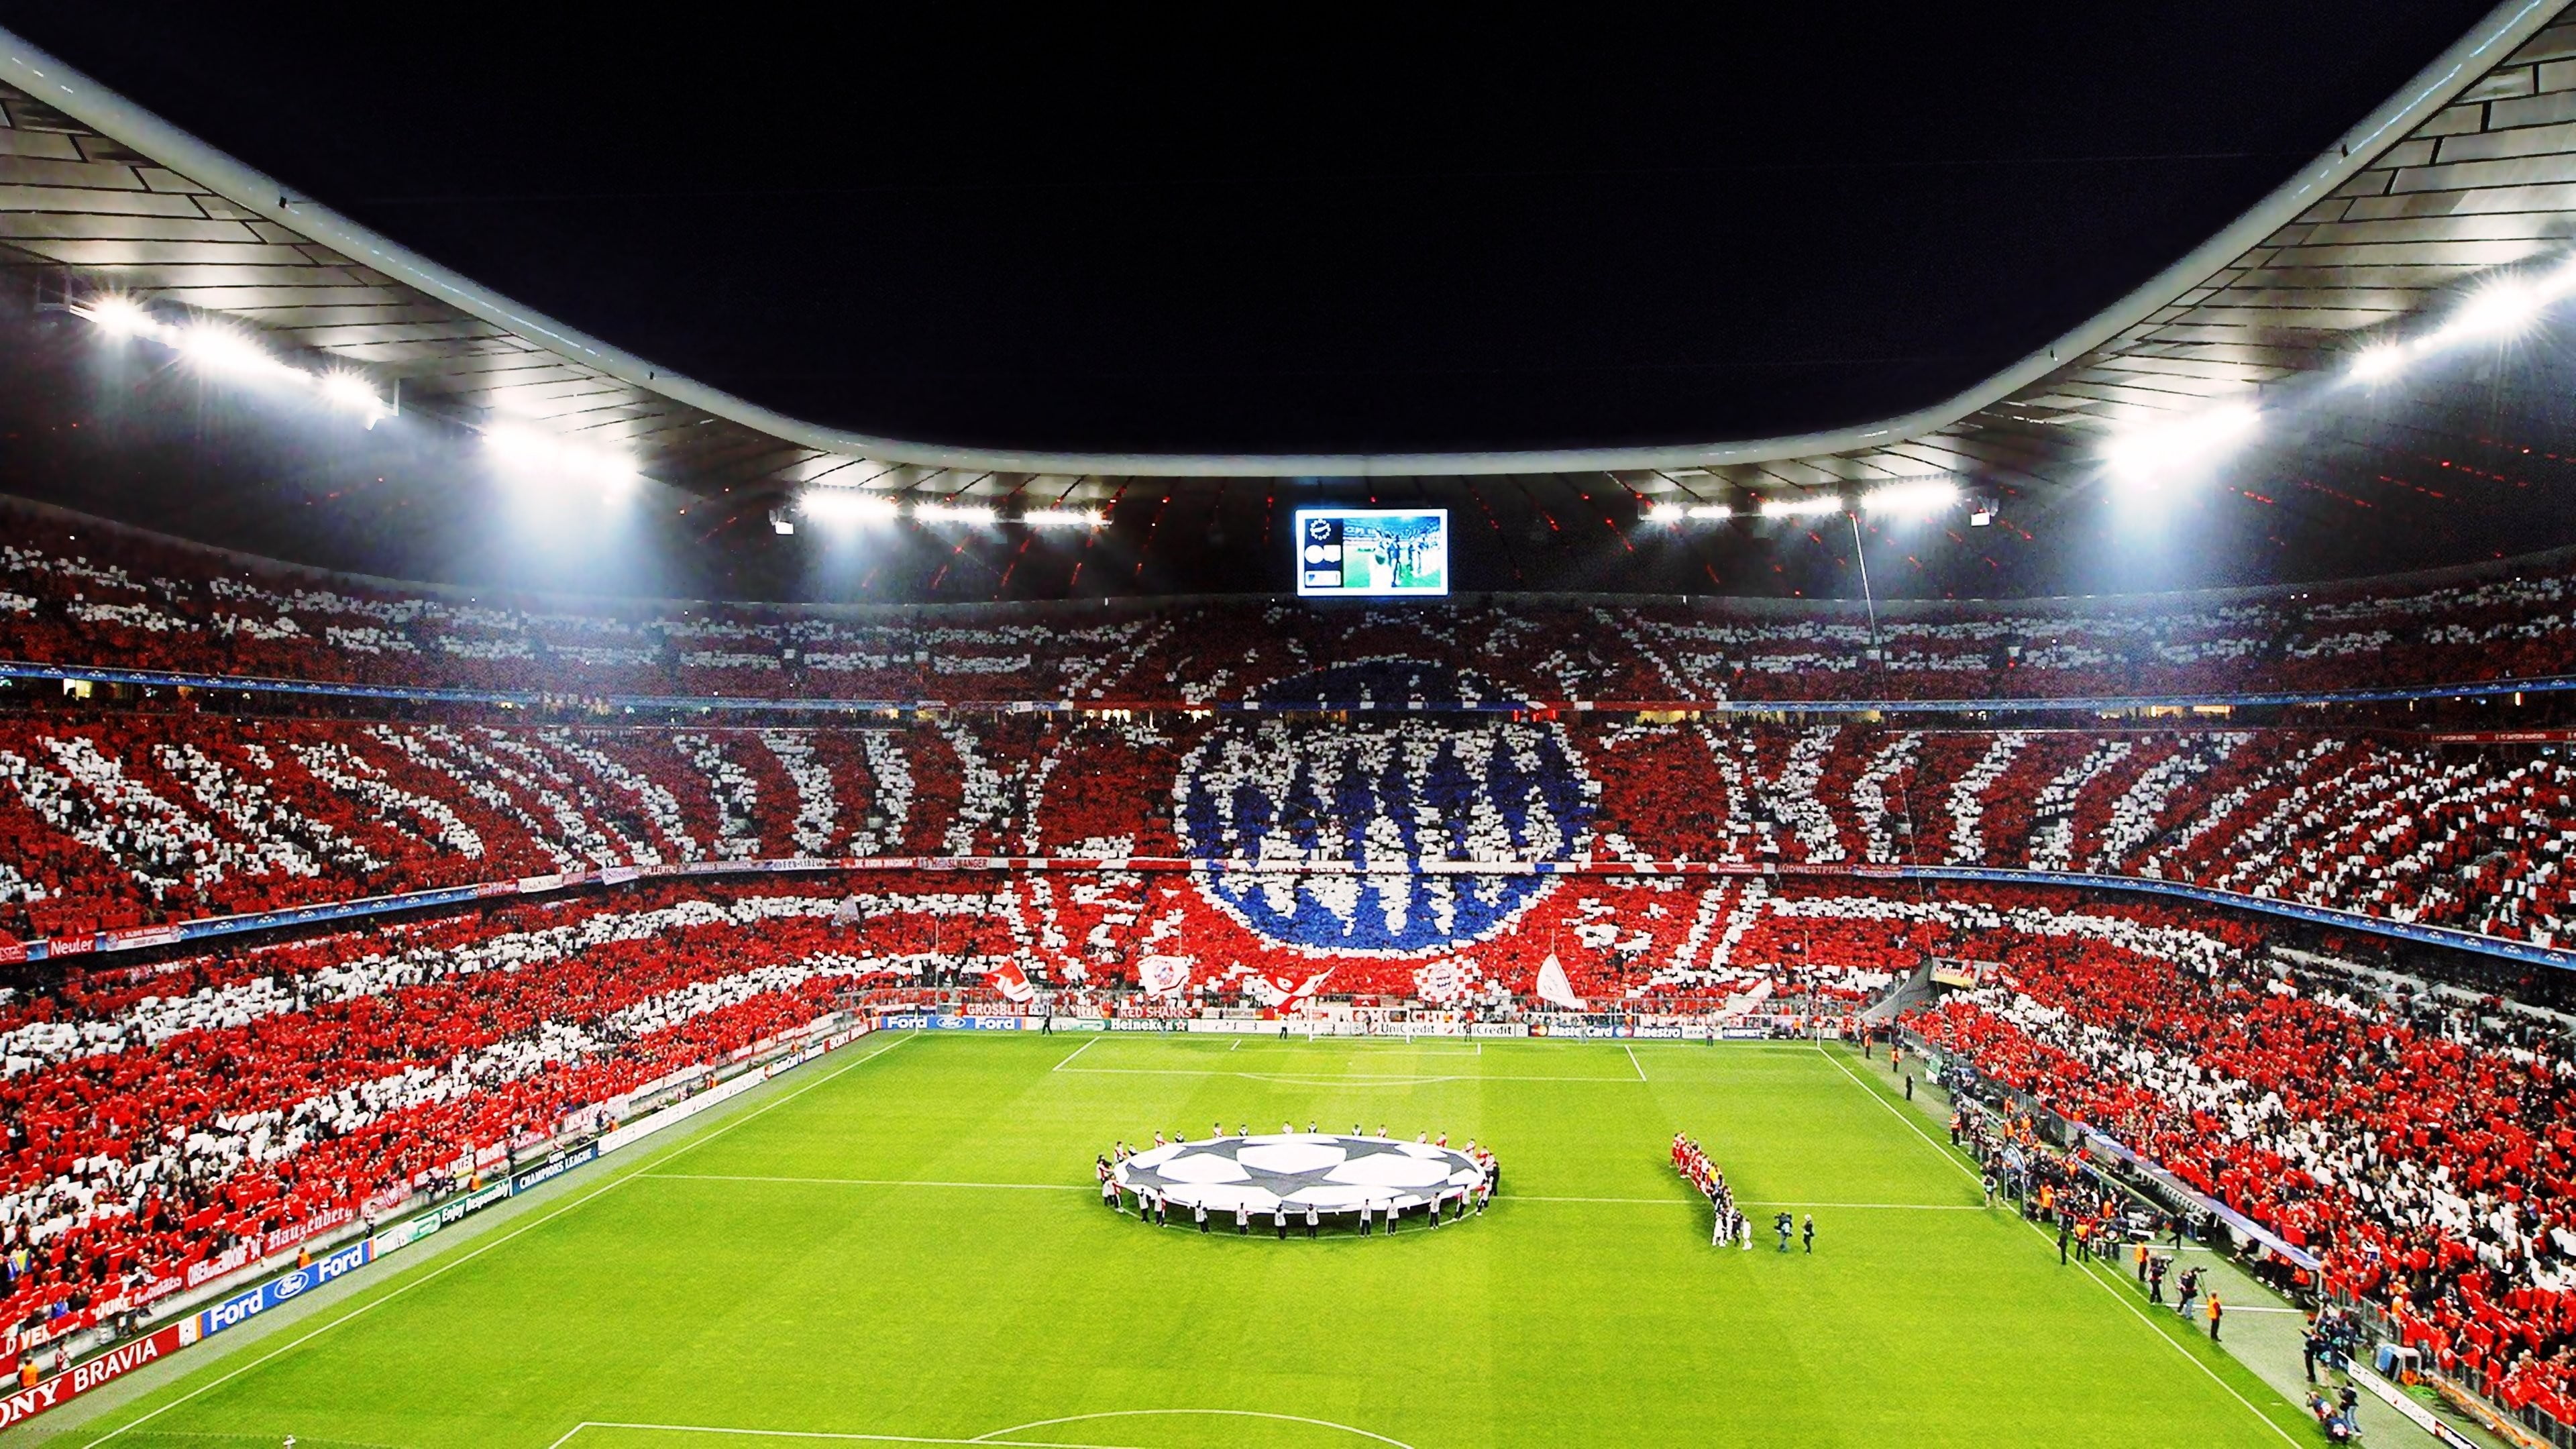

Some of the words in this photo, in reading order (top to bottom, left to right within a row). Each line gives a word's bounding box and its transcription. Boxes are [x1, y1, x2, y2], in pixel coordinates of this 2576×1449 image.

[50, 939, 94, 956] Neuler
[1120, 1006, 1143, 1018] RED
[1146, 1006, 1193, 1018] SHARKS
[887, 1016, 928, 1029] Ford
[975, 1017, 1015, 1030] Ford
[1381, 1021, 1434, 1034] UniCredit
[1457, 1022, 1512, 1035] UiCredit
[1633, 1026, 1681, 1038] Maestro
[519, 1161, 565, 1189] CHAMPIONS
[565, 1148, 592, 1171] LEAGUE
[441, 1203, 465, 1224] Enjoy
[466, 1181, 510, 1214] Responsibly
[268, 1207, 353, 1251] Hauzenberg
[319, 1242, 363, 1283] Ford
[211, 1287, 263, 1332] Ford
[74, 1338, 158, 1393] BRAVIA
